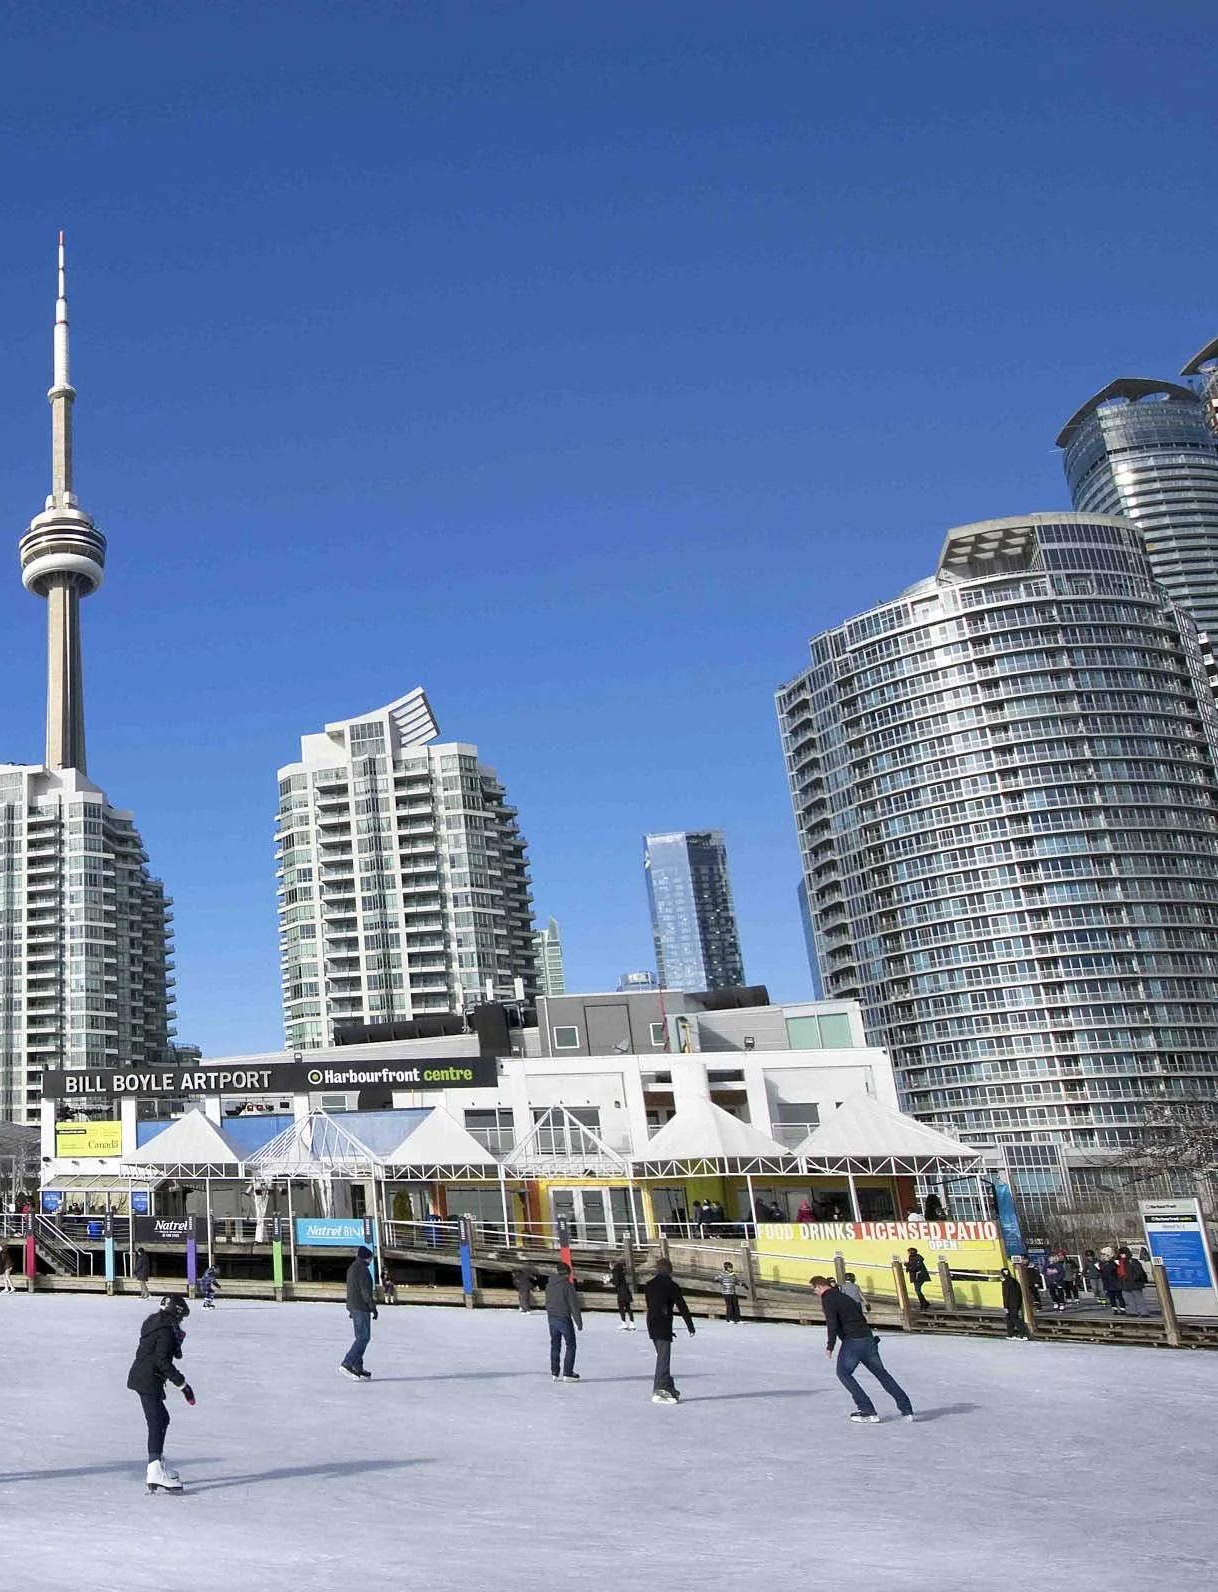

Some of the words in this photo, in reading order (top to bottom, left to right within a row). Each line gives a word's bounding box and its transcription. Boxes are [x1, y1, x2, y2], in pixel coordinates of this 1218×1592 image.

[324, 1067, 421, 1084] Harbourfront
[423, 1066, 473, 1082] centre
[65, 1075, 107, 1093] BILL
[113, 1073, 175, 1092] BOYLE
[180, 1070, 272, 1090] ARTPORT
[88, 1139, 119, 1149] Canada
[154, 1220, 188, 1231] Natrel
[307, 1225, 341, 1236] Natrel
[756, 1223, 794, 1240] FOOD
[799, 1222, 856, 1240] DRINKS
[861, 1221, 942, 1240] LICENSED
[945, 1221, 997, 1241] PATIO
[929, 1240, 958, 1250] OPEN
